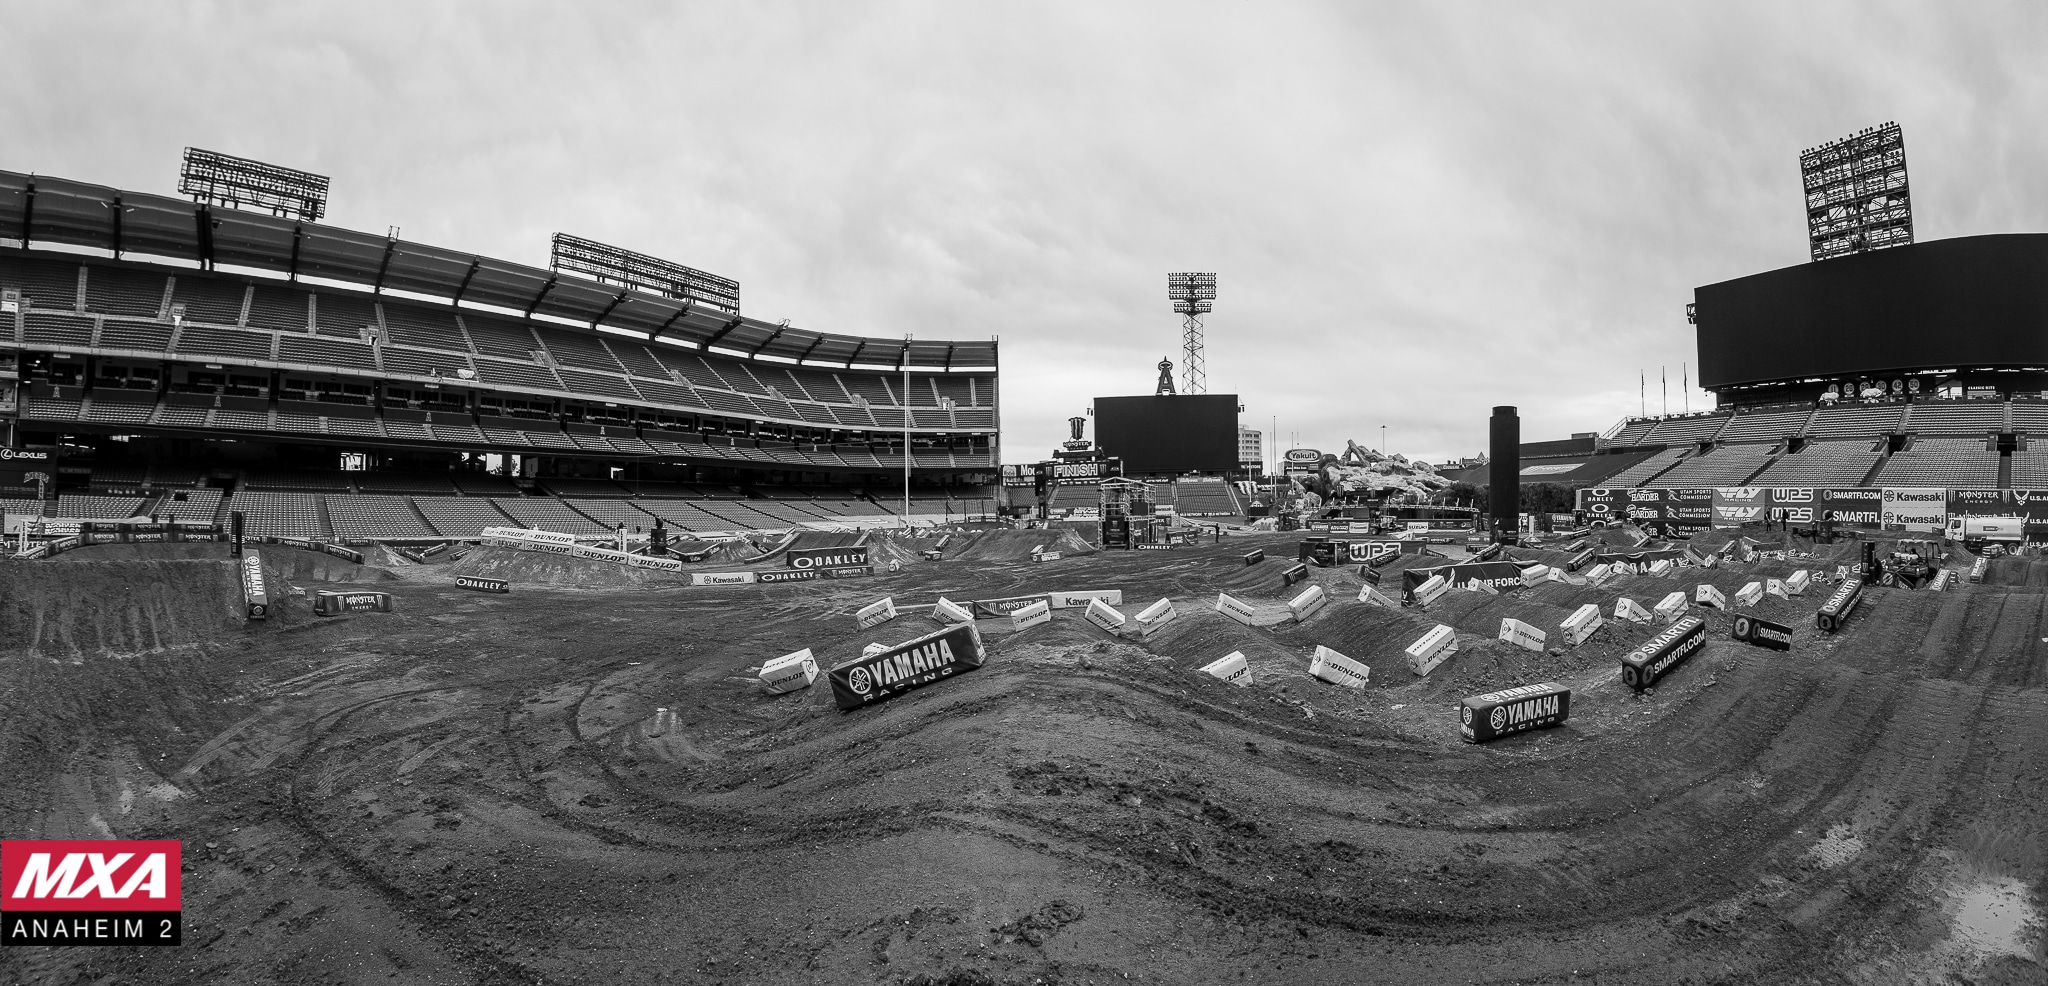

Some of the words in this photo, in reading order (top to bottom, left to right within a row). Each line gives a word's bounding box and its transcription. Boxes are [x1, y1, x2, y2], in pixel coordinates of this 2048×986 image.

[13, 451, 47, 459] LEXUS
[1292, 451, 1316, 459] Yakult
[1053, 463, 1098, 478] FINISH
[1773, 487, 1814, 502] WPS
[1833, 491, 1880, 500] SMARTFI.COM
[1896, 492, 1945, 501] Kawasaki
[1959, 491, 1999, 499] MONSTER
[1715, 506, 1762, 517] FLY
[1896, 514, 1944, 524] Kawasaki
[499, 530, 525, 538] DUNLOP
[534, 534, 572, 543] DUNLOP
[497, 540, 522, 548] DUNLOP
[533, 543, 570, 553] DUNLOP
[583, 551, 625, 563] DUNLOP
[639, 559, 680, 569] DUNLOP
[815, 553, 866, 567] OAKLEY
[249, 564, 265, 596] YAMAHA
[712, 576, 745, 584] Kawasaki
[776, 571, 815, 580] OAKLEY
[1495, 576, 1521, 588] FORC
[467, 580, 501, 590] OAKLEY
[1426, 581, 1445, 597] DUNLOP
[346, 595, 376, 605] MONSTER
[1302, 594, 1324, 612] DUNLOP
[864, 608, 889, 622] DUNLOP
[1020, 610, 1048, 624] DUNLOP
[1147, 606, 1172, 626] DUNLOP
[1227, 603, 1253, 618] DUNLOP
[1095, 613, 1121, 630] DUNLOP
[1579, 612, 1600, 633] DUNLOP
[1519, 630, 1545, 645] DUNLOP
[1759, 627, 1792, 643] SMARTFI.COM
[1427, 637, 1455, 662] DUNLOP
[1653, 629, 1706, 675] SMARTFI.COM
[868, 638, 956, 687] YAMAHA
[1331, 662, 1367, 681] DUNLOP
[771, 672, 805, 687] DUNLOP
[863, 667, 953, 702] RACING
[1494, 683, 1553, 697] YAMAHA
[1507, 694, 1559, 725] YAMAHA
[1496, 717, 1555, 735] RACING
